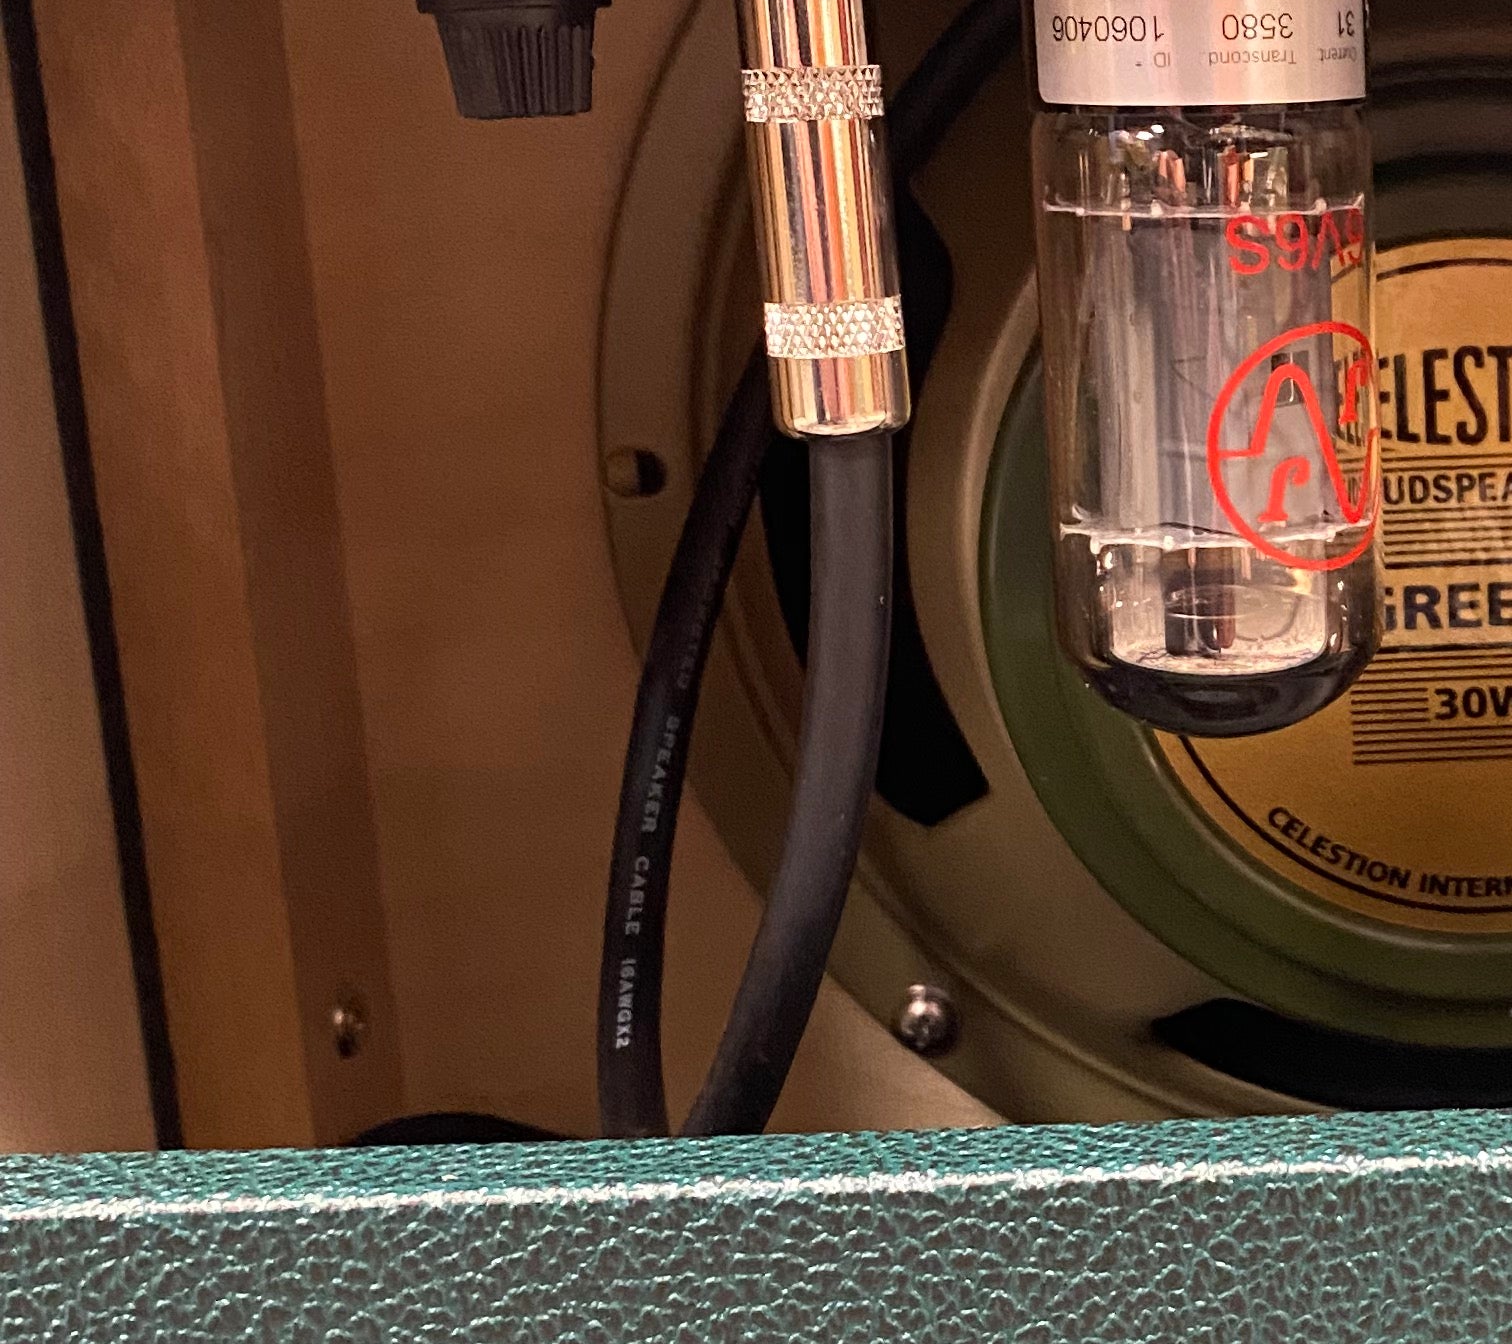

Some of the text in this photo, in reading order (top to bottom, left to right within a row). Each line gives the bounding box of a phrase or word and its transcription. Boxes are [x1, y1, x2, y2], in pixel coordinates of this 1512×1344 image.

[1052, 10, 1356, 43] 31 3580 1060406
[641, 715, 682, 833] SPEAKER
[1267, 805, 1410, 889] CELESTION
[624, 856, 651, 936] CABLE
